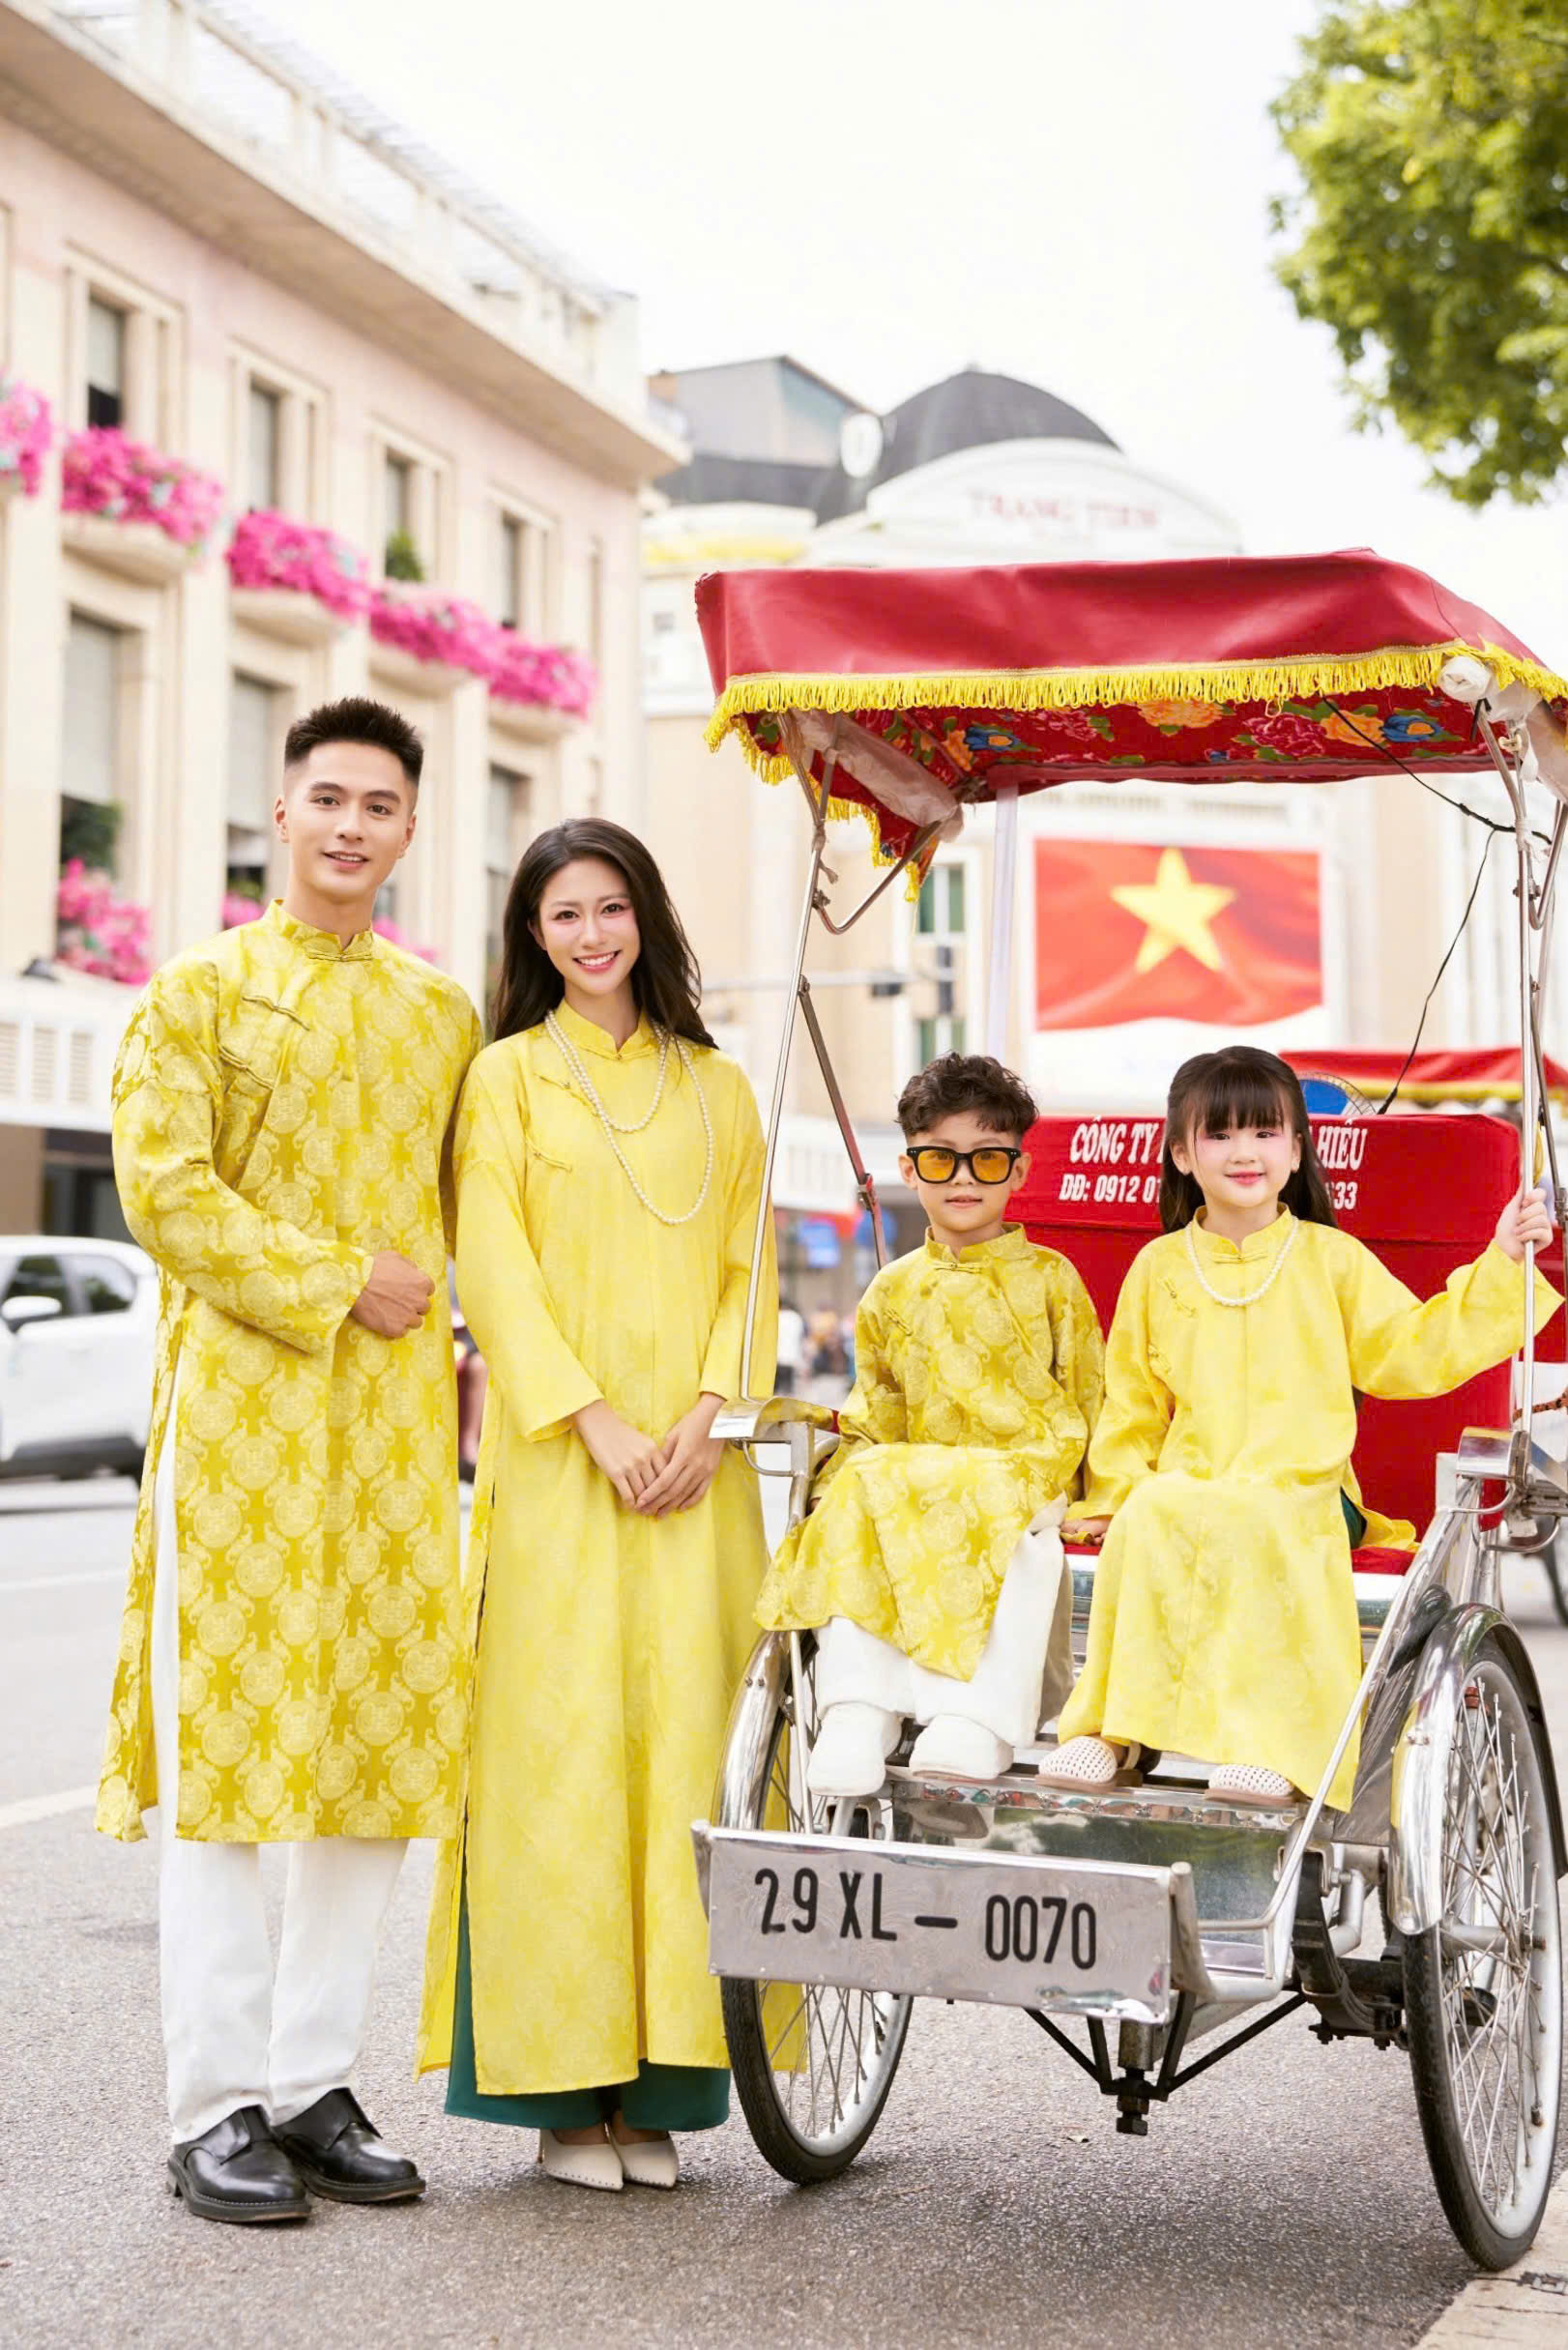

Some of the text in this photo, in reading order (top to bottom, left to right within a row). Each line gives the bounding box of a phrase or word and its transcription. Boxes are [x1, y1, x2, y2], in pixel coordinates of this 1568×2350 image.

[1069, 1114, 1127, 1164] CÔNG
[1127, 1122, 1159, 1165] TY
[1093, 1175, 1142, 1203] 0912
[754, 1867, 819, 1935] 29
[838, 1871, 898, 1941] XL
[984, 1894, 1097, 1970] 0070
